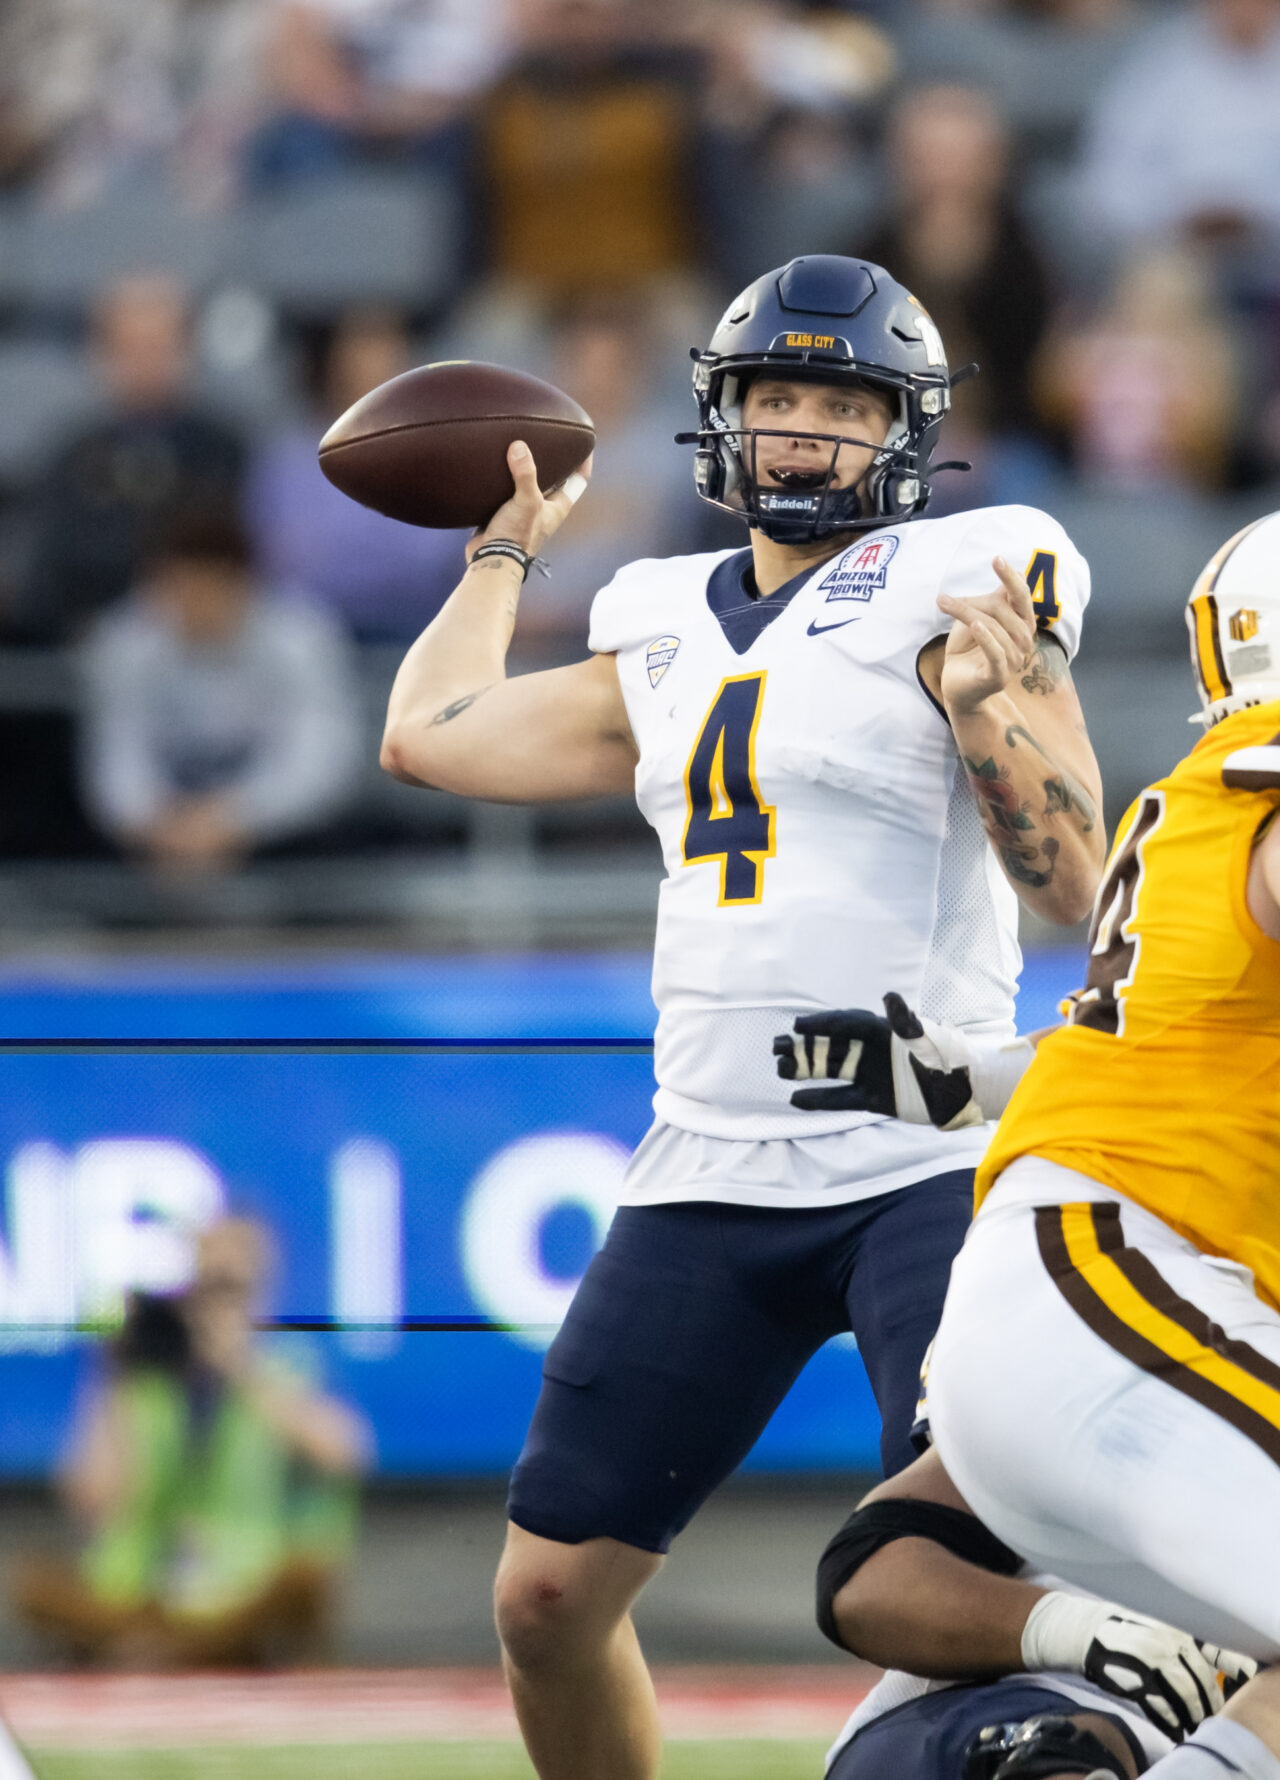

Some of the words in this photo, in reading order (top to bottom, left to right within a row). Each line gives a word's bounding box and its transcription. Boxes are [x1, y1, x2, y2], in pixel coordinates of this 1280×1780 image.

[786, 334, 812, 347] GLASS
[814, 335, 835, 349] CITY
[769, 499, 812, 510] Riddell
[827, 571, 882, 583] ARIZONA
[832, 584, 868, 595] BOWL
[1025, 548, 1062, 630] 4
[681, 669, 777, 907] 4
